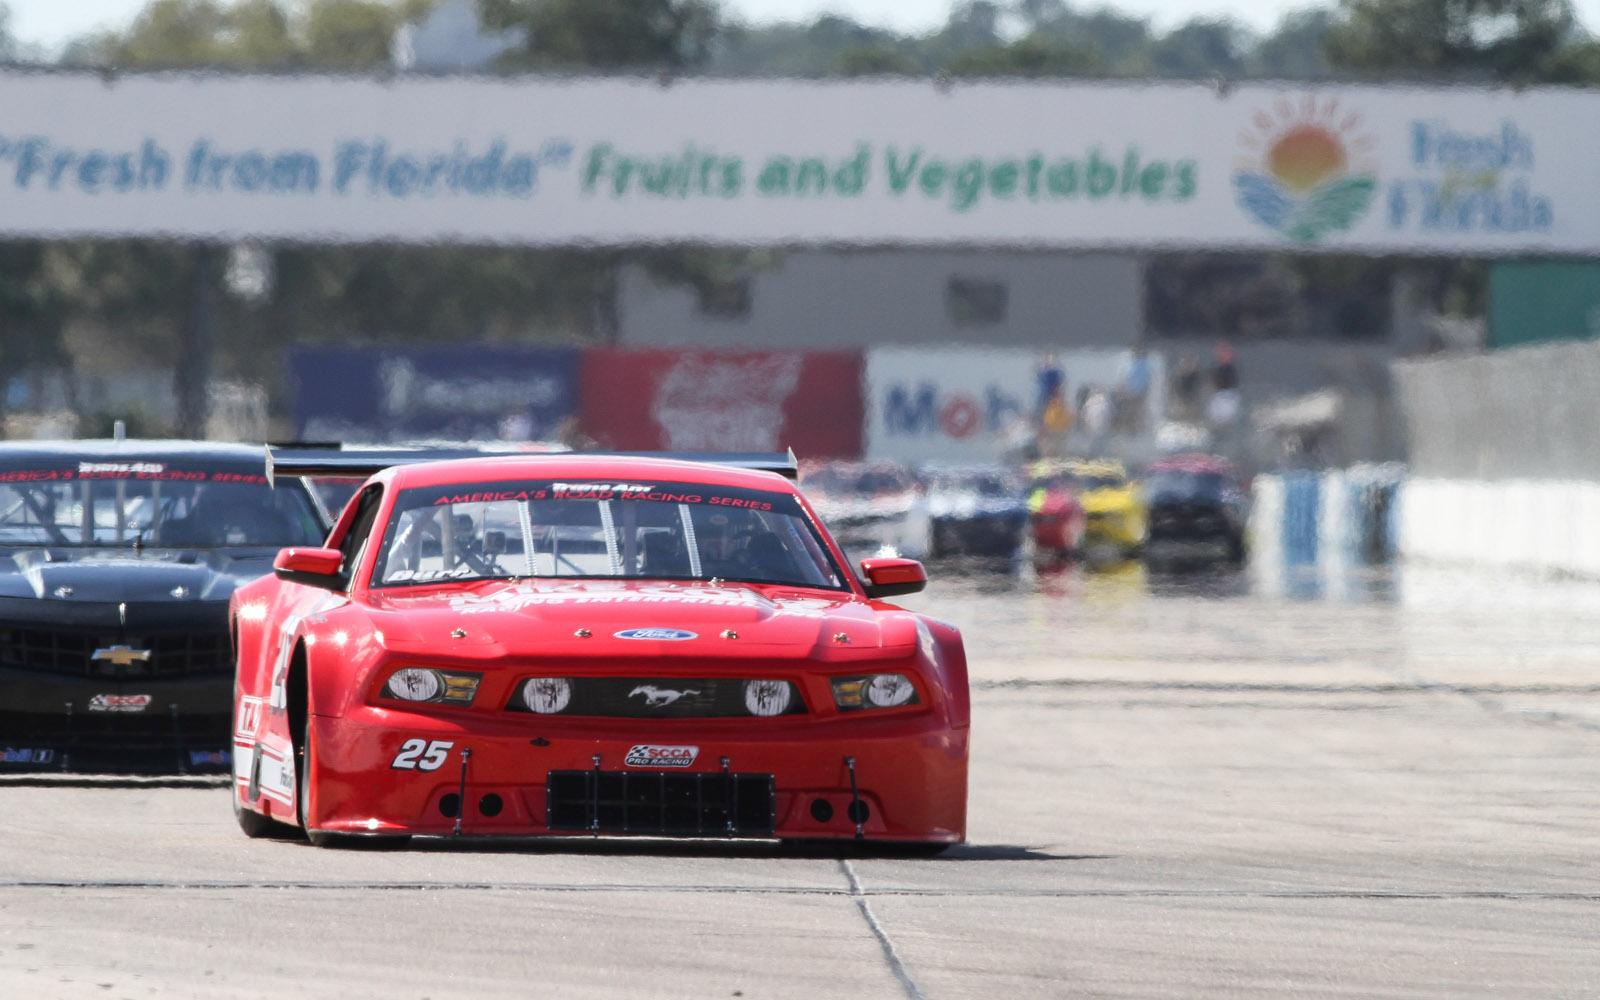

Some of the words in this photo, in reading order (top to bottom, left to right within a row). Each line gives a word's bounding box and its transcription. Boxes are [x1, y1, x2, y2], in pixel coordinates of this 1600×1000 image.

[186, 137, 320, 194] from
[581, 142, 744, 199] Fruits
[757, 141, 872, 198] and
[885, 143, 1197, 213] Vegetables
[433, 490, 546, 505] AMERICA'S
[553, 490, 614, 501] ROAD
[621, 491, 702, 503] RACING
[709, 496, 773, 511] SERIES
[391, 738, 454, 772] 25
[628, 757, 649, 765] PRO
[650, 758, 690, 766] RACING
[648, 748, 692, 758] SCCA
